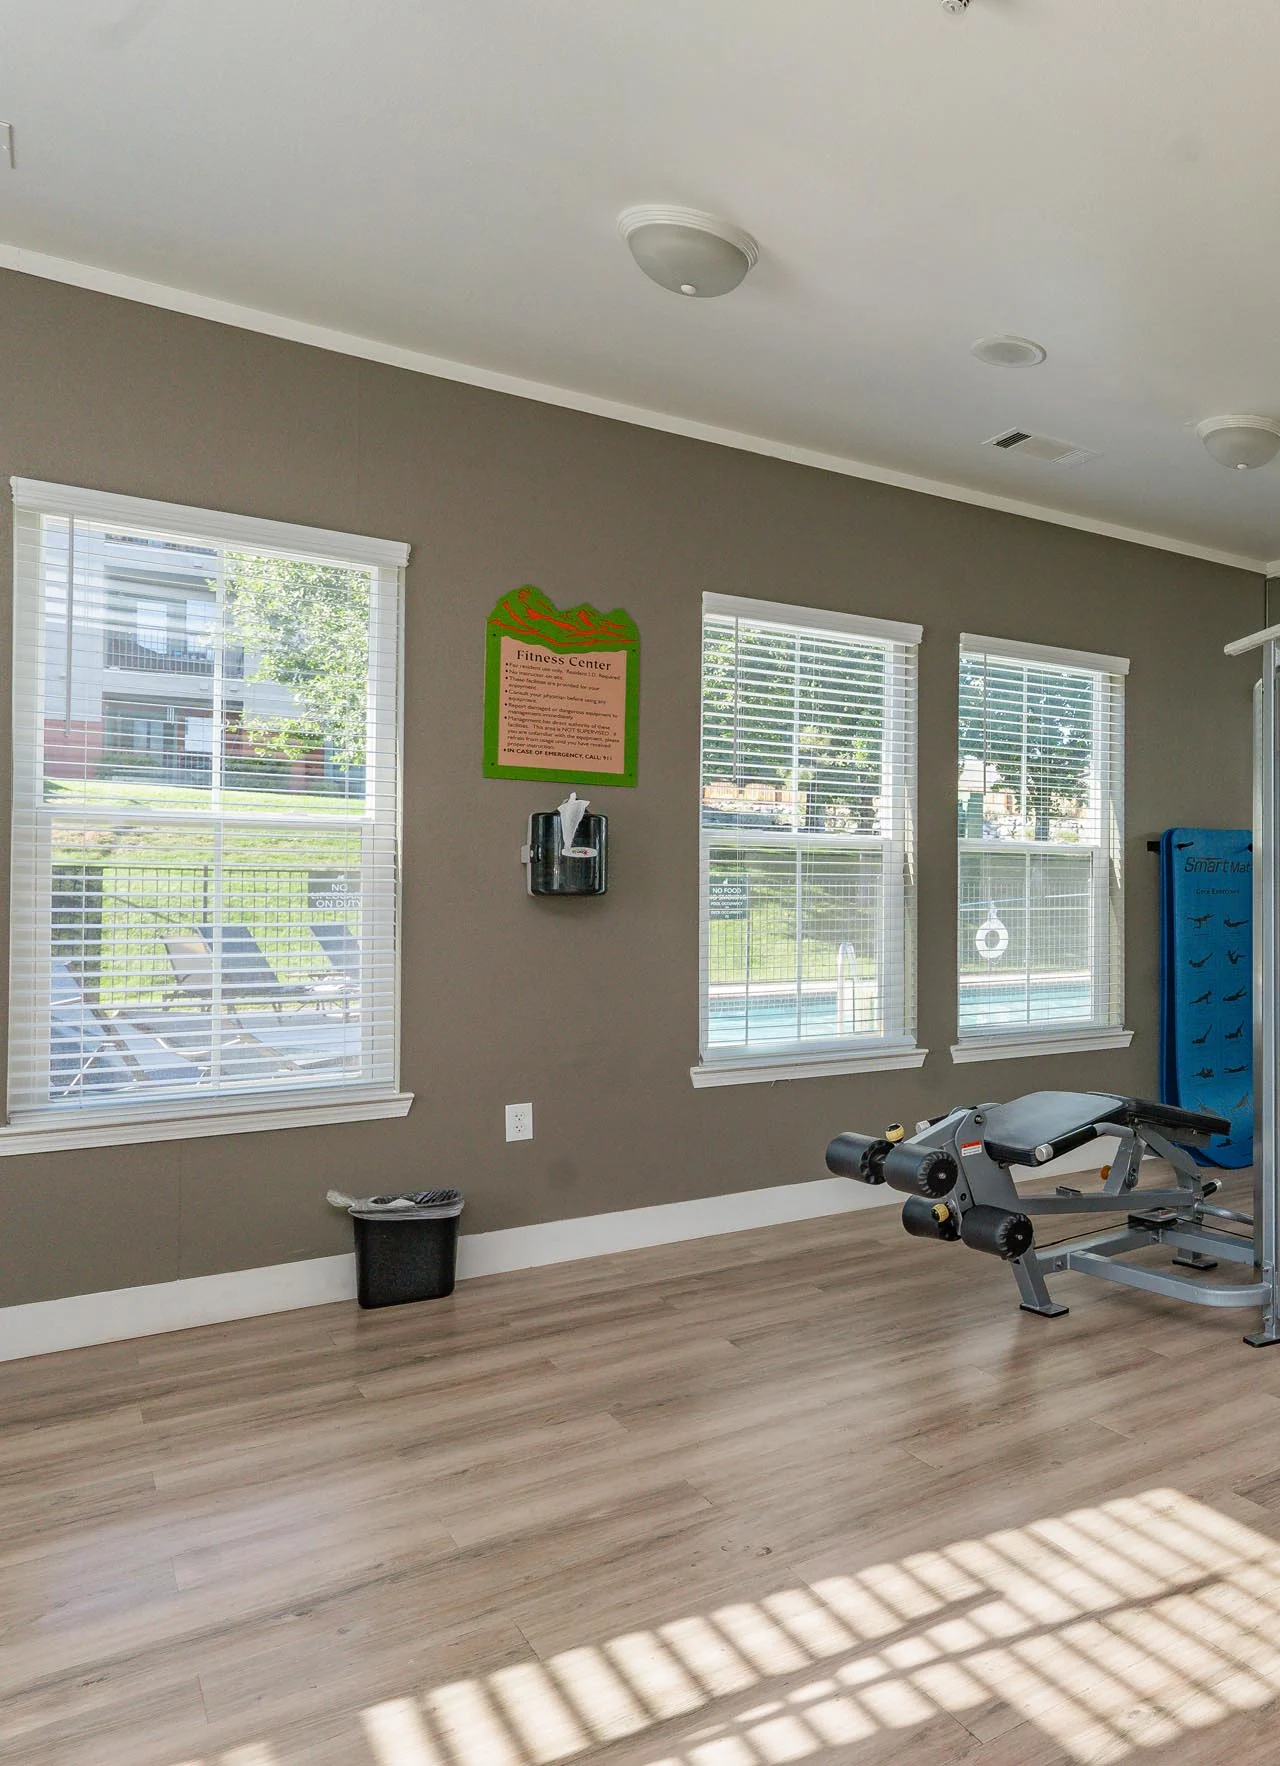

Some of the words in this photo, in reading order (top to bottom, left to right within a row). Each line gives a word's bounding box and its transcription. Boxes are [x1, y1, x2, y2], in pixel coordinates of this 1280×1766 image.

[517, 650, 565, 665] Fitness
[569, 656, 612, 670] Center
[1184, 856, 1230, 873] Smart
[316, 900, 333, 908] ON
